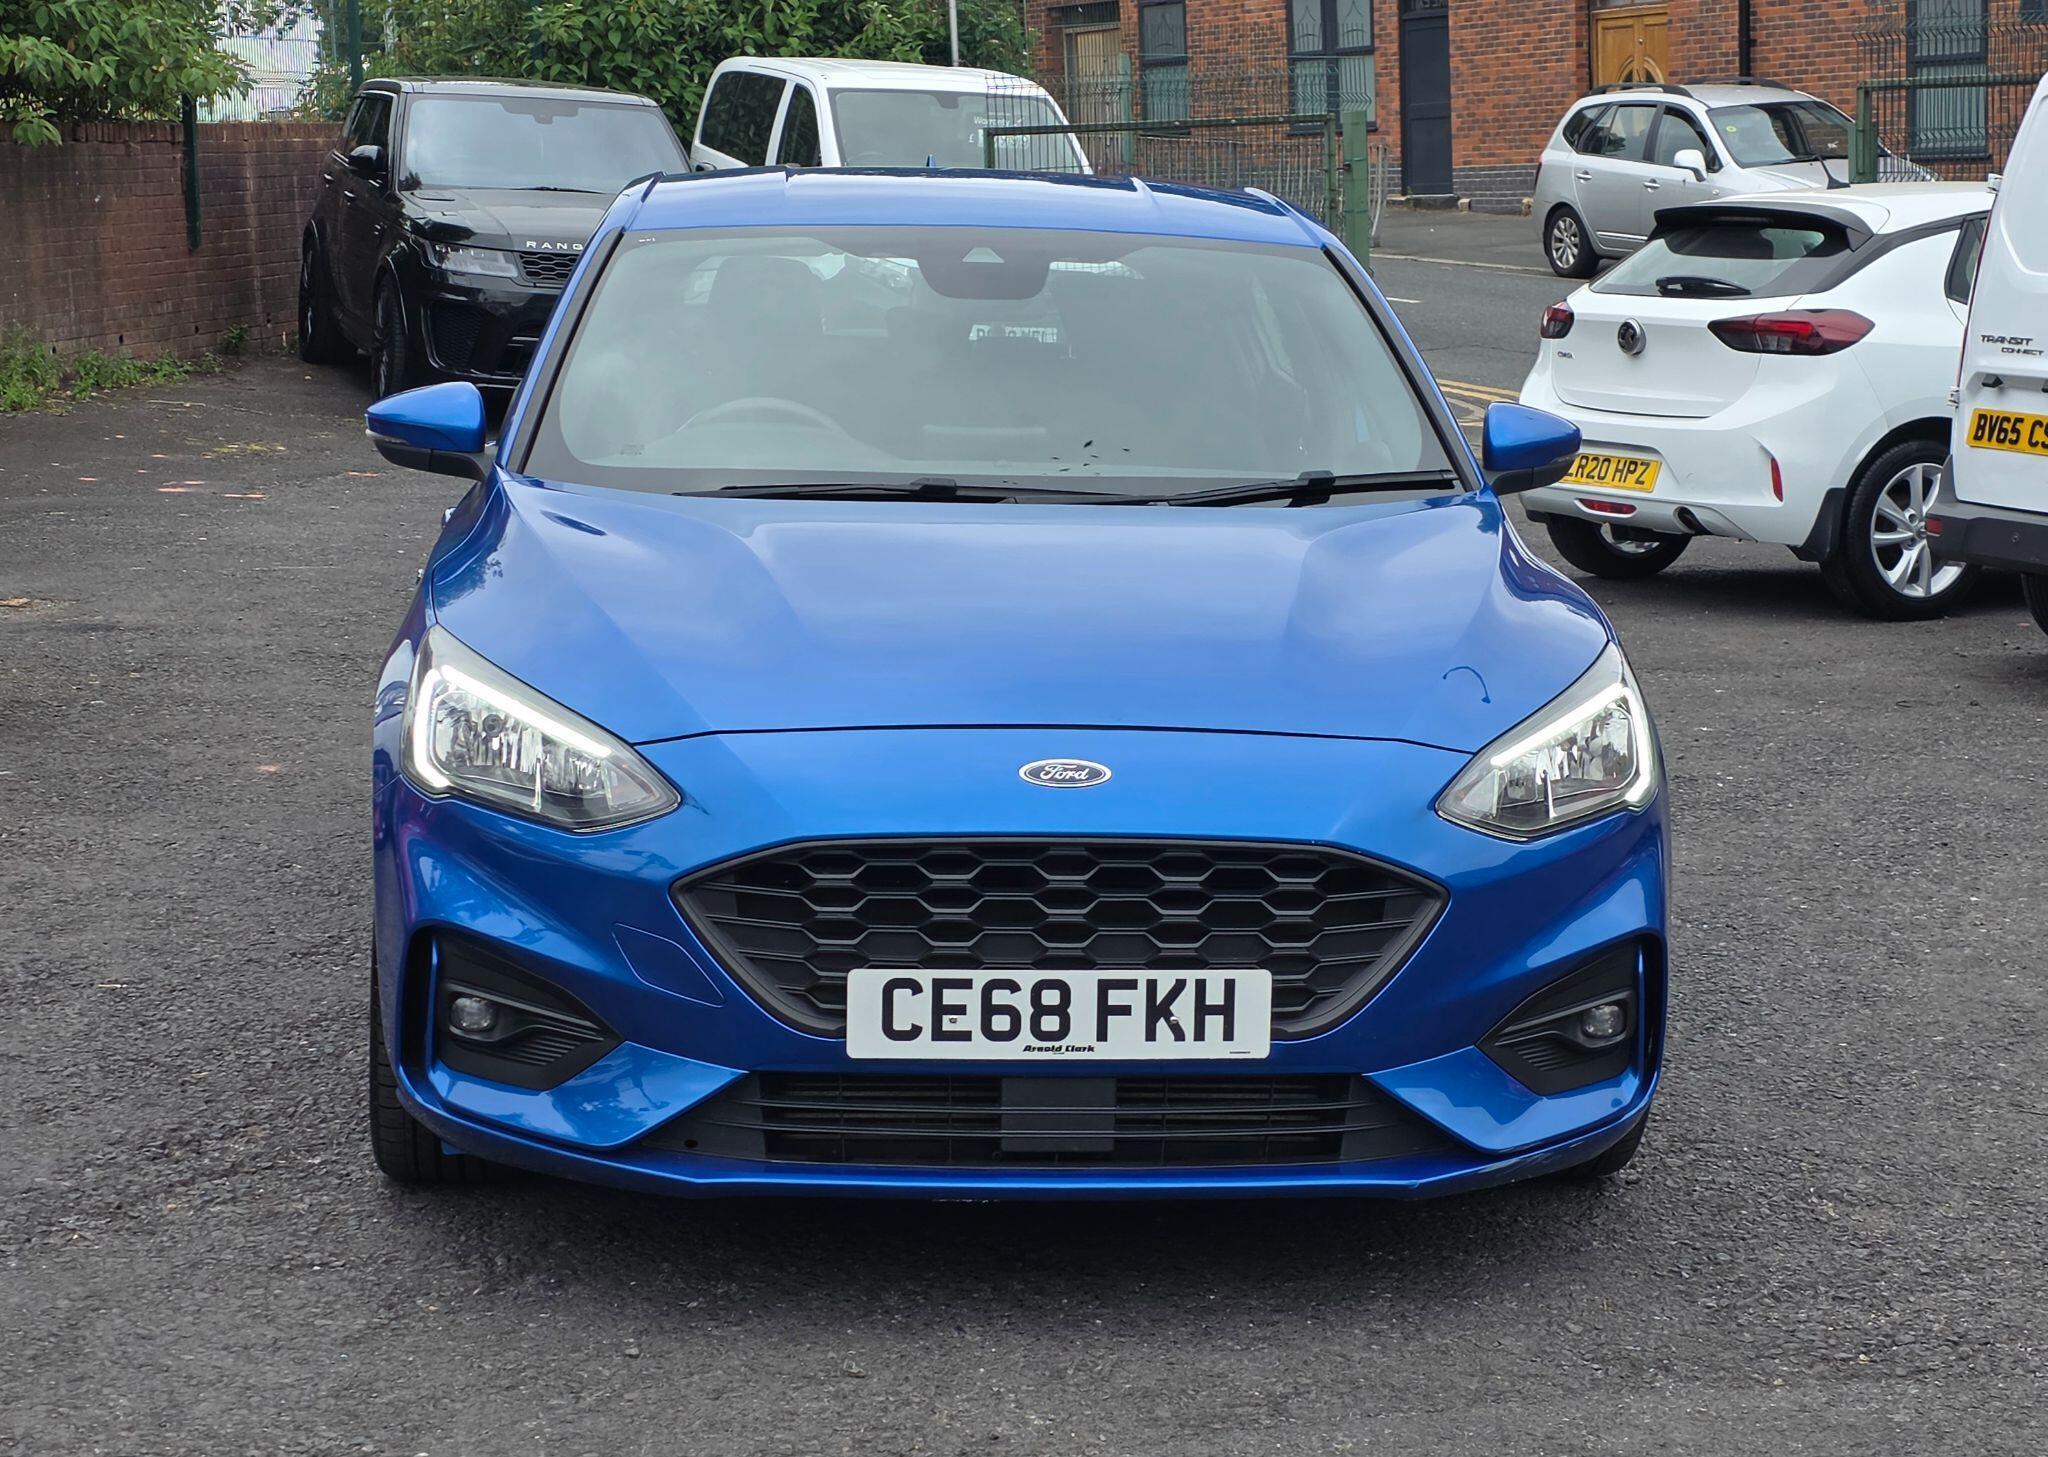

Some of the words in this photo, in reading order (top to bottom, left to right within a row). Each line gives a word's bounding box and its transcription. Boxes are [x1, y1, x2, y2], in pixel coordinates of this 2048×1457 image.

[1981, 334, 2034, 346] TRANSIT
[1973, 413, 2024, 446] BV65
[1564, 455, 1611, 480] R20
[1612, 459, 1652, 485] HPZ
[1040, 764, 1090, 780] Ford
[882, 977, 1071, 1042] CE68
[1096, 978, 1236, 1042] FKH
[1023, 1044, 1063, 1053] Arnold
[1065, 1044, 1095, 1053] Clark
